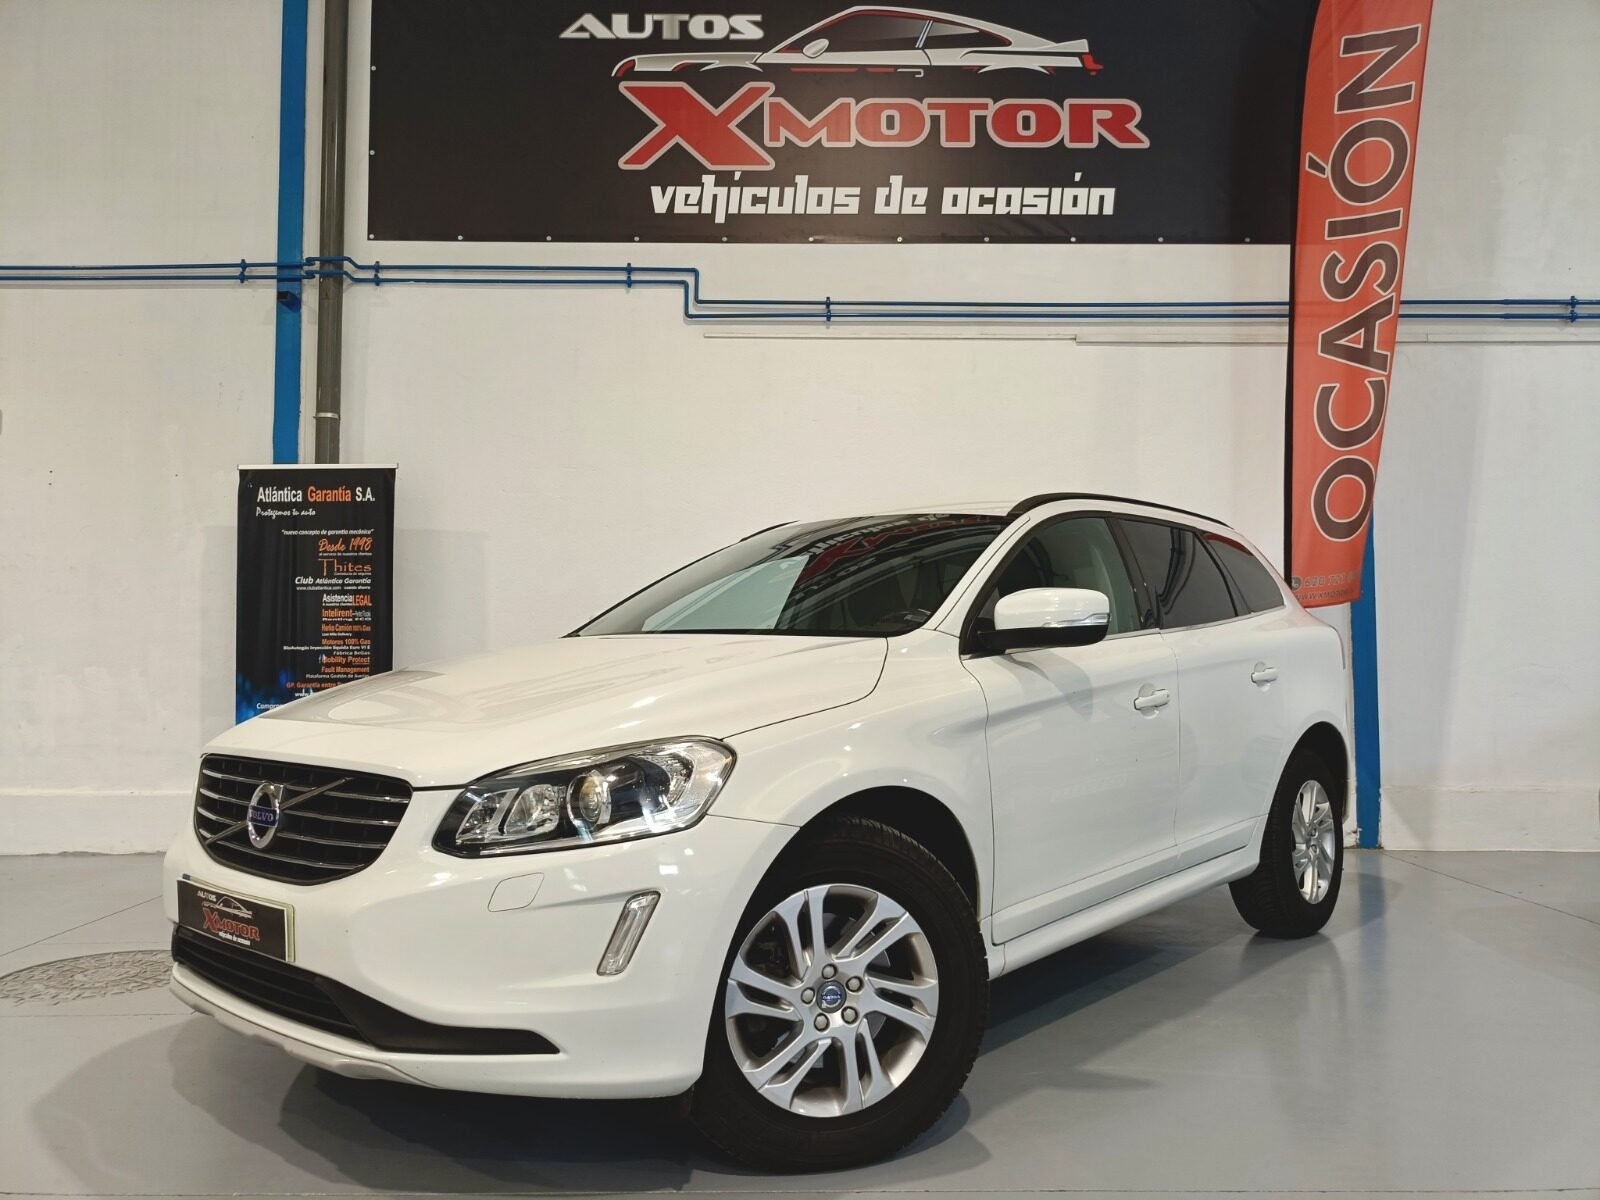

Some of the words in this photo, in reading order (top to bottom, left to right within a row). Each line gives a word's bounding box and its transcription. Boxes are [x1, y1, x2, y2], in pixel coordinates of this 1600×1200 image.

[559, 13, 763, 40] AUTOS
[874, 175, 928, 215] de
[941, 172, 1116, 215] ocasión
[1306, 23, 1421, 542] OCASIÓN
[257, 486, 303, 502] Atlántica
[307, 485, 352, 502] Garantía
[355, 486, 376, 502] S.A.
[318, 538, 346, 552] Desde
[348, 537, 373, 551] 1998
[318, 558, 372, 577] Thites
[295, 576, 314, 585] Club
[347, 656, 370, 664] Protect
[335, 665, 370, 673] Management
